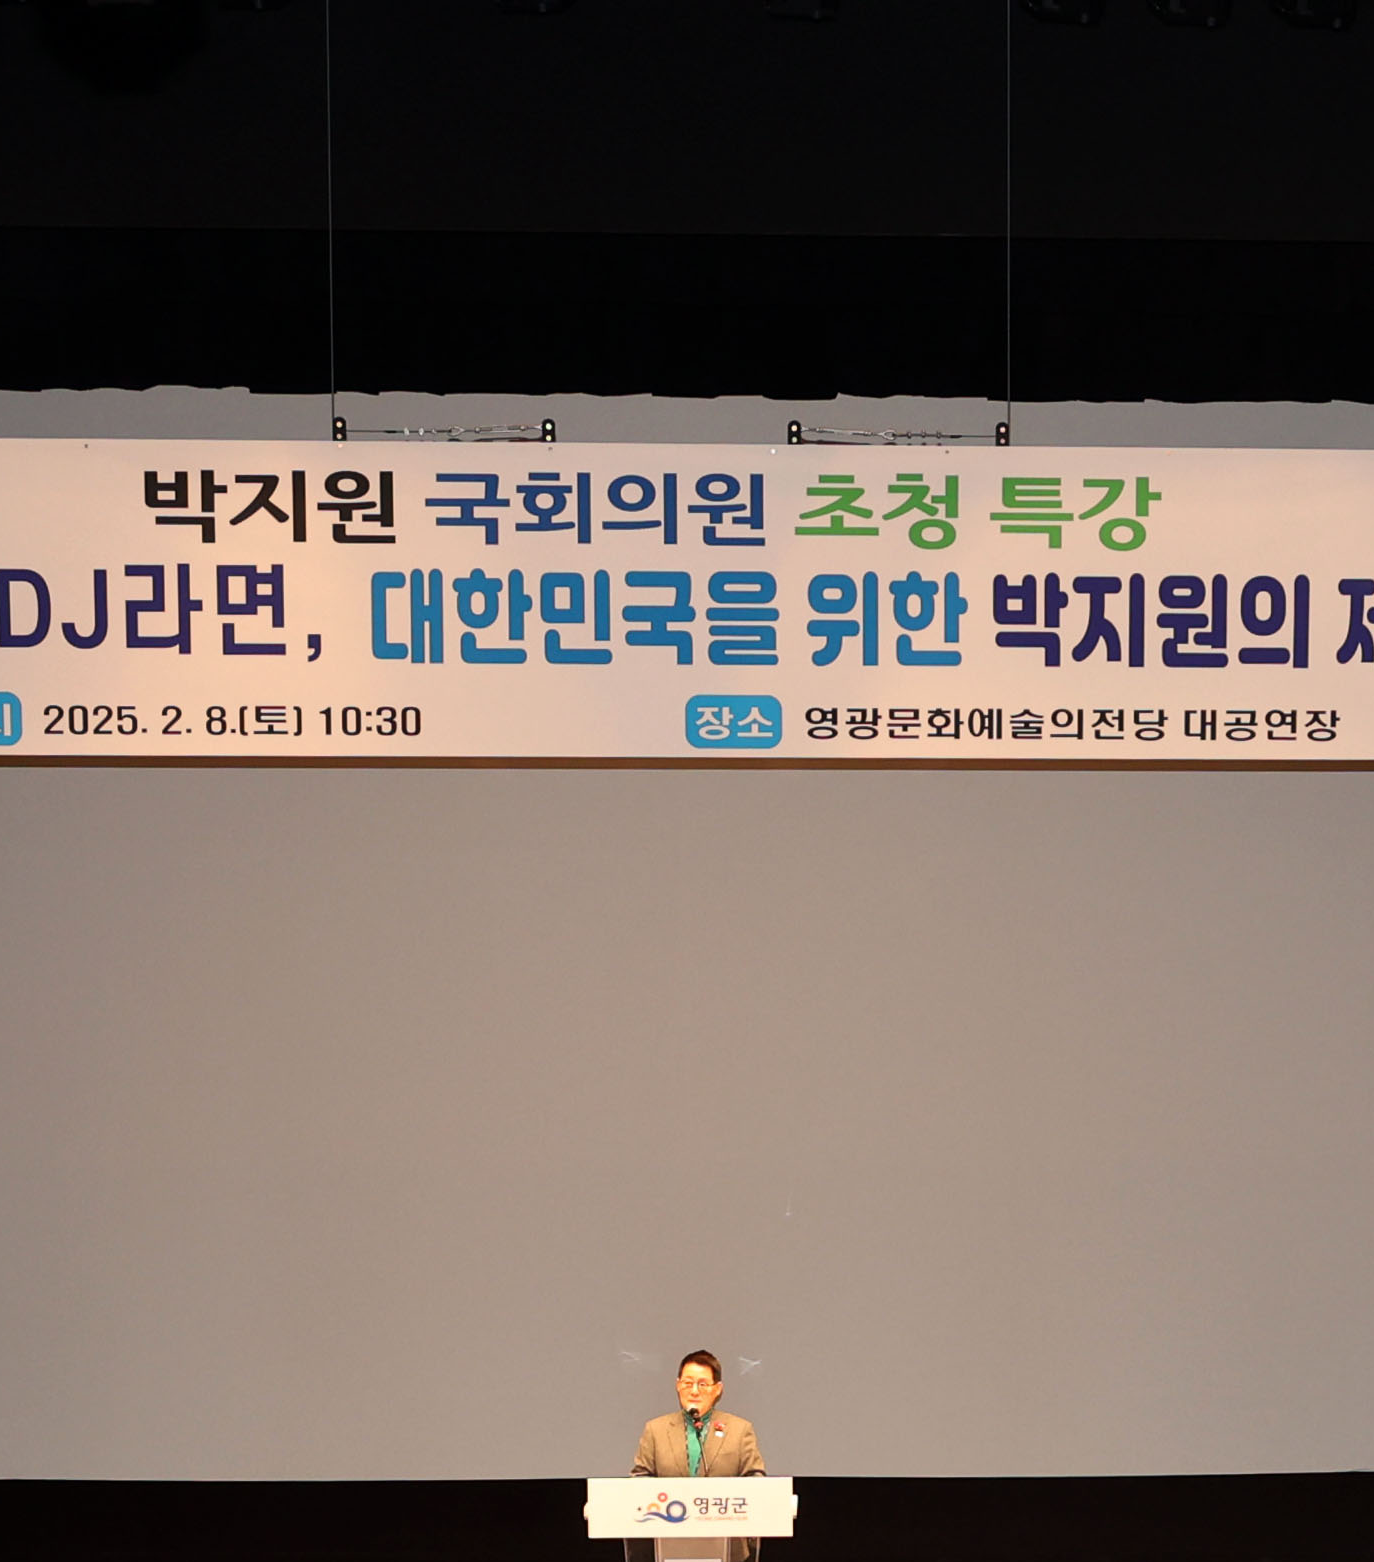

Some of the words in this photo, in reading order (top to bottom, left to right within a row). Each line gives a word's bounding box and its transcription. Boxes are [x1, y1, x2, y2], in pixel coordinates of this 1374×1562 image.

[142, 468, 398, 545] 박지원
[423, 470, 767, 548] 국회의원
[793, 472, 961, 551] 초청
[988, 475, 1163, 553] 특강
[370, 567, 781, 667] 대한민국을
[805, 569, 970, 668] 위한
[991, 570, 1312, 670] 박지원의
[42, 703, 149, 737] 2025.
[160, 704, 193, 736] 2.
[318, 705, 423, 738] 10:30
[695, 706, 774, 741] 장소
[803, 706, 1170, 743] 영광문화예술의전당
[1182, 708, 1342, 743] 대공연장
[693, 1497, 748, 1515] 영광군
